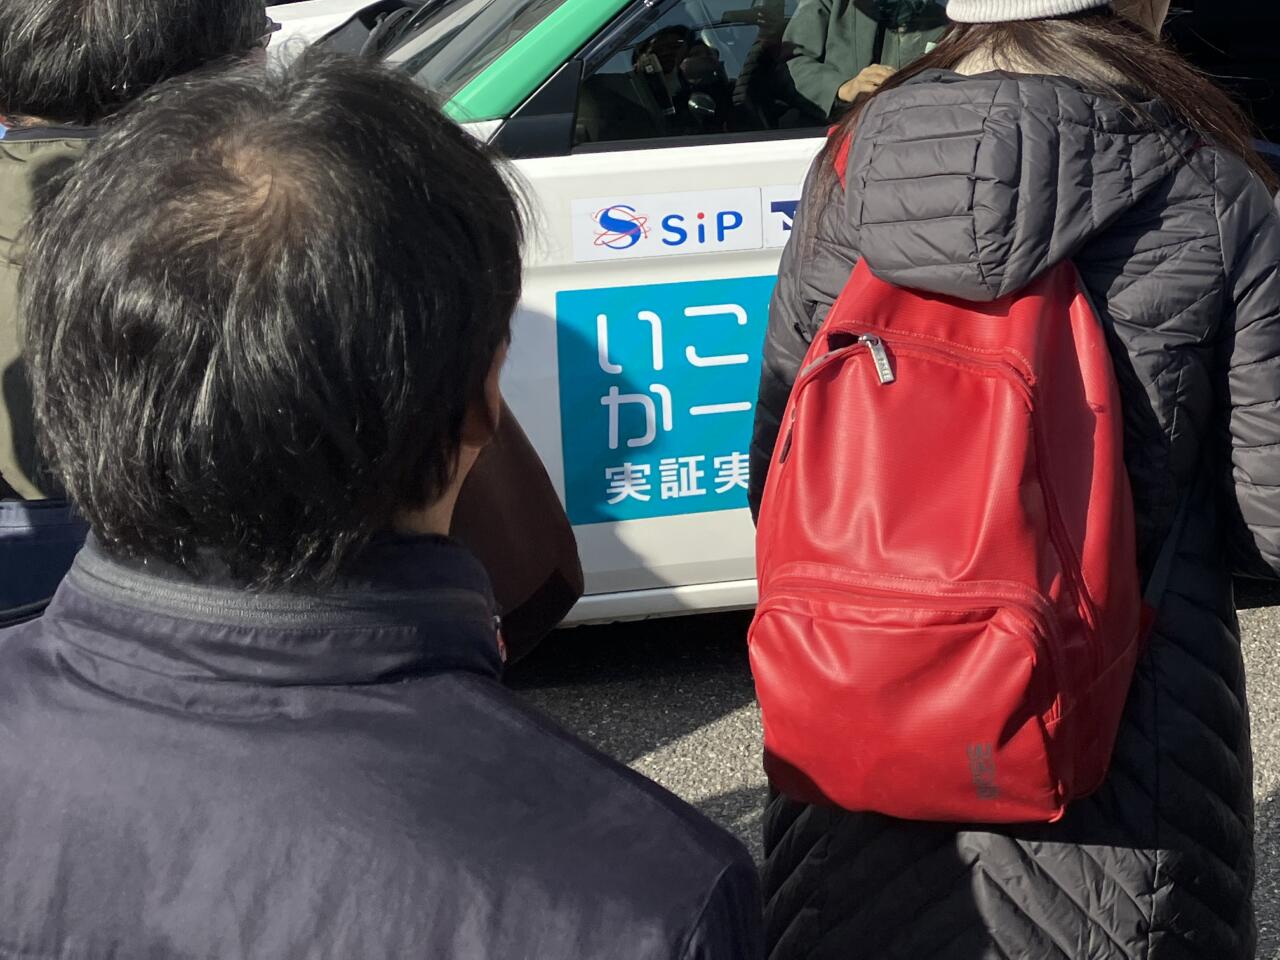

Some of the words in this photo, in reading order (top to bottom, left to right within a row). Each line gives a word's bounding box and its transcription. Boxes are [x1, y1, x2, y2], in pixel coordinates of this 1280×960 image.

[661, 210, 743, 246] SiP
[596, 303, 749, 375] いこ
[605, 452, 750, 505] 実証実
